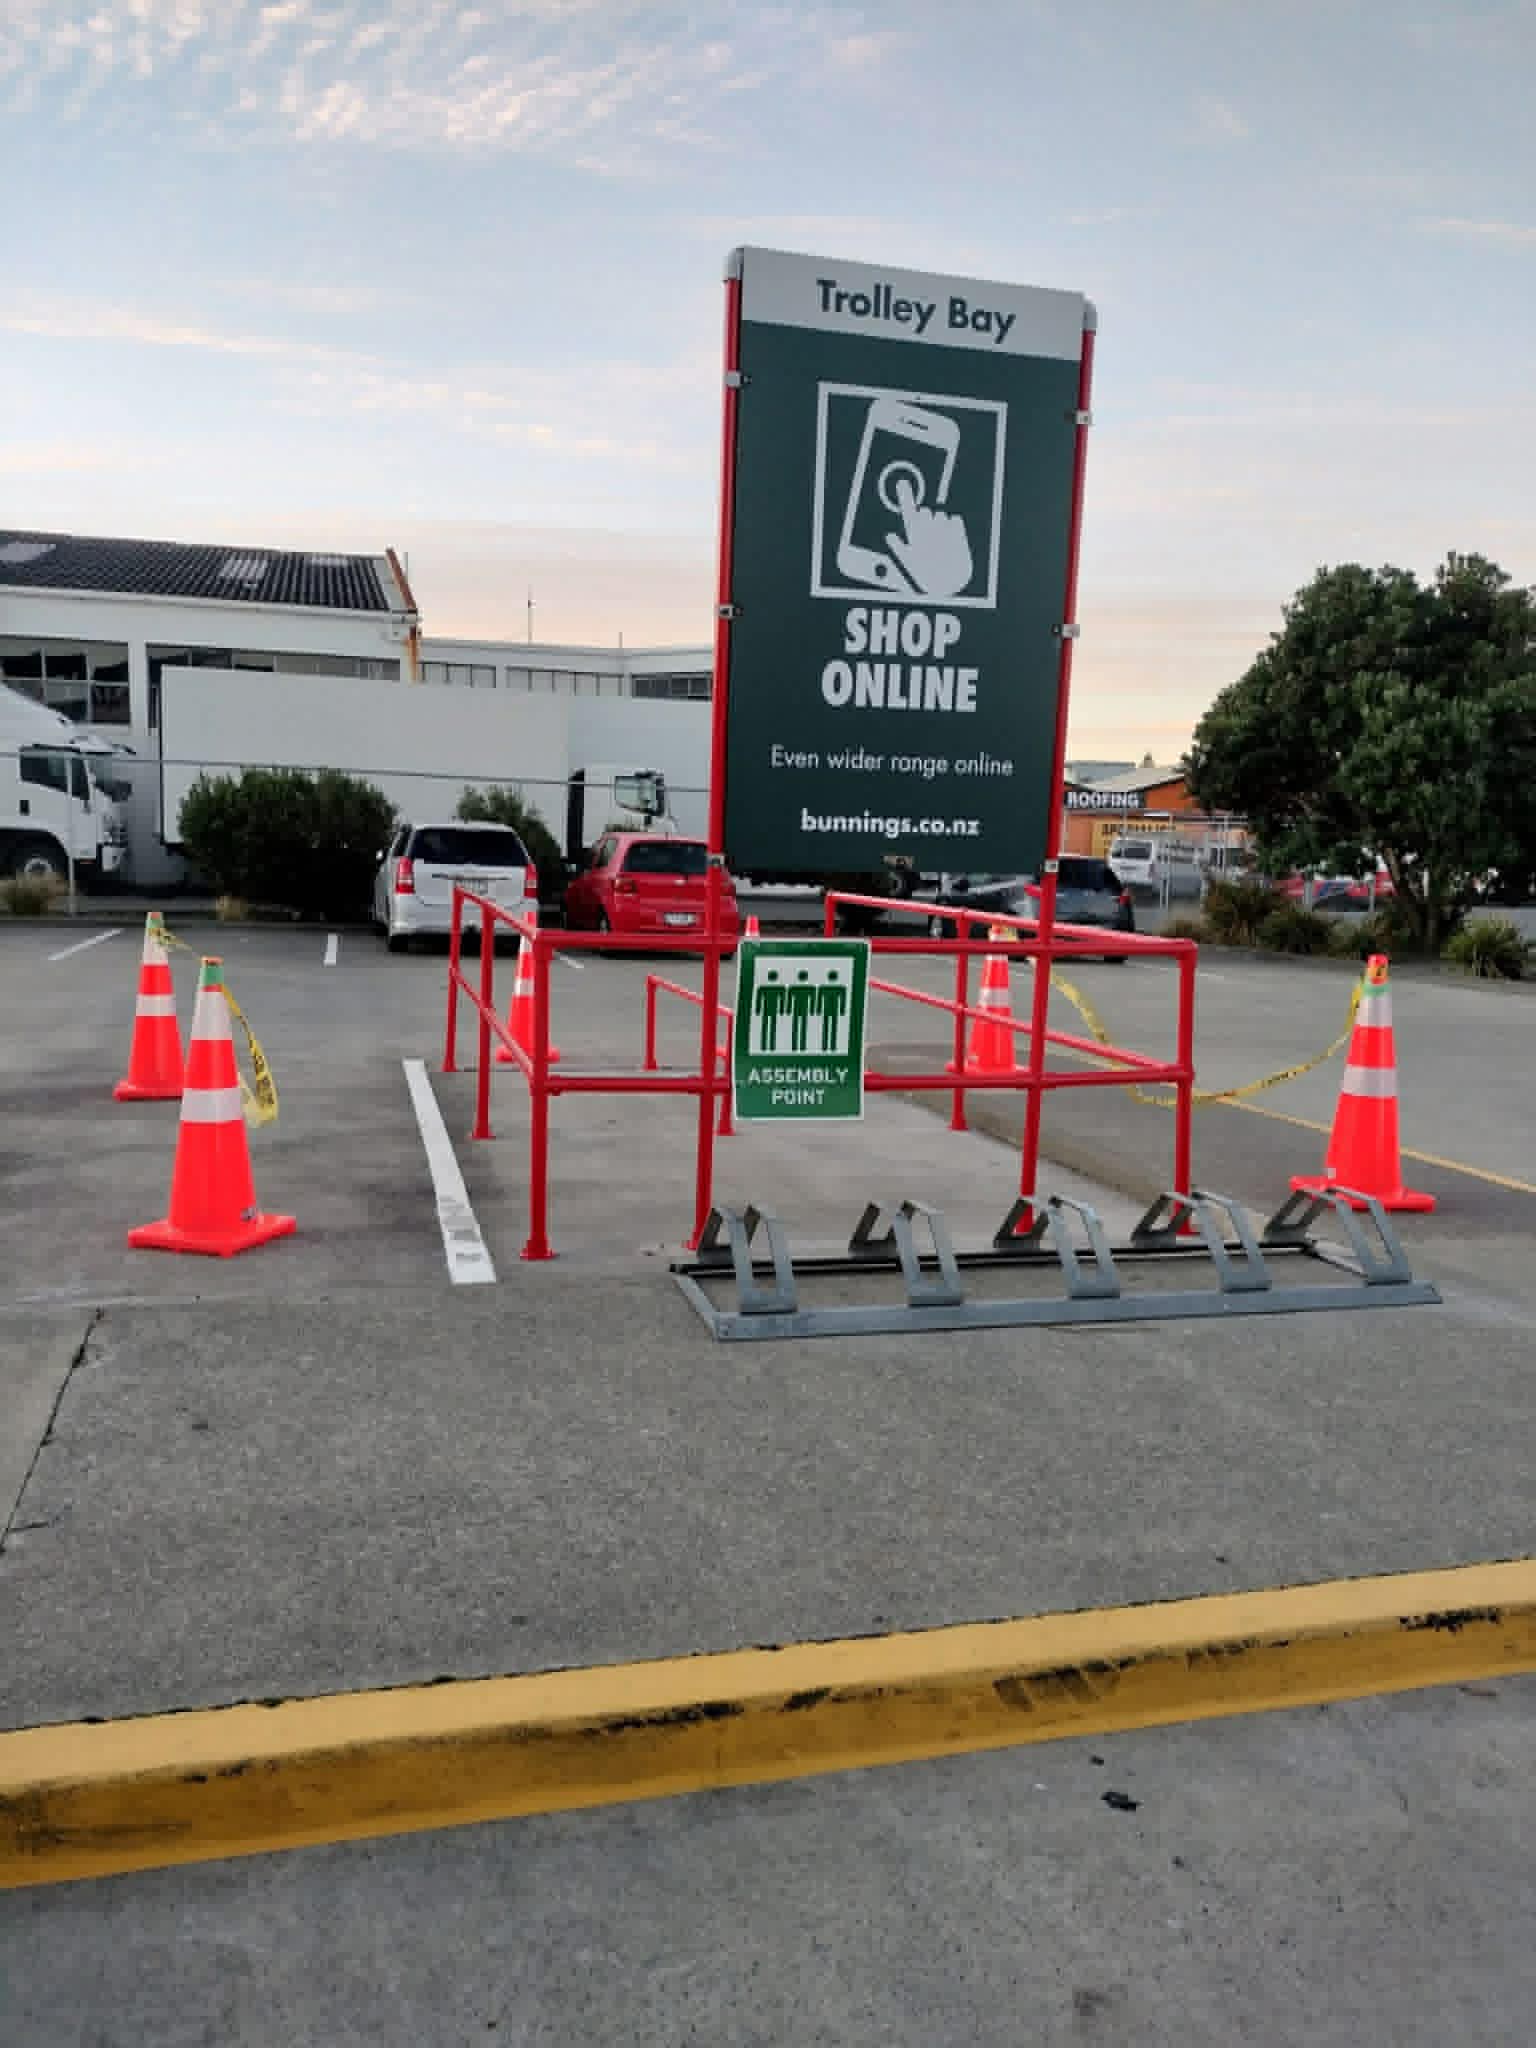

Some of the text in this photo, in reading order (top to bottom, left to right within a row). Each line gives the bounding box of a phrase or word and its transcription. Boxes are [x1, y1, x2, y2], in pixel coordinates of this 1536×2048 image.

[816, 279, 1016, 344] Trolley Bay
[845, 607, 961, 658] SHOP
[822, 660, 979, 712] ONLINE
[771, 744, 1014, 780] Even wider range online
[800, 808, 981, 839] bunnings.co.nz
[749, 1067, 848, 1084] ASSEMBLY
[771, 1089, 825, 1105] POINT
